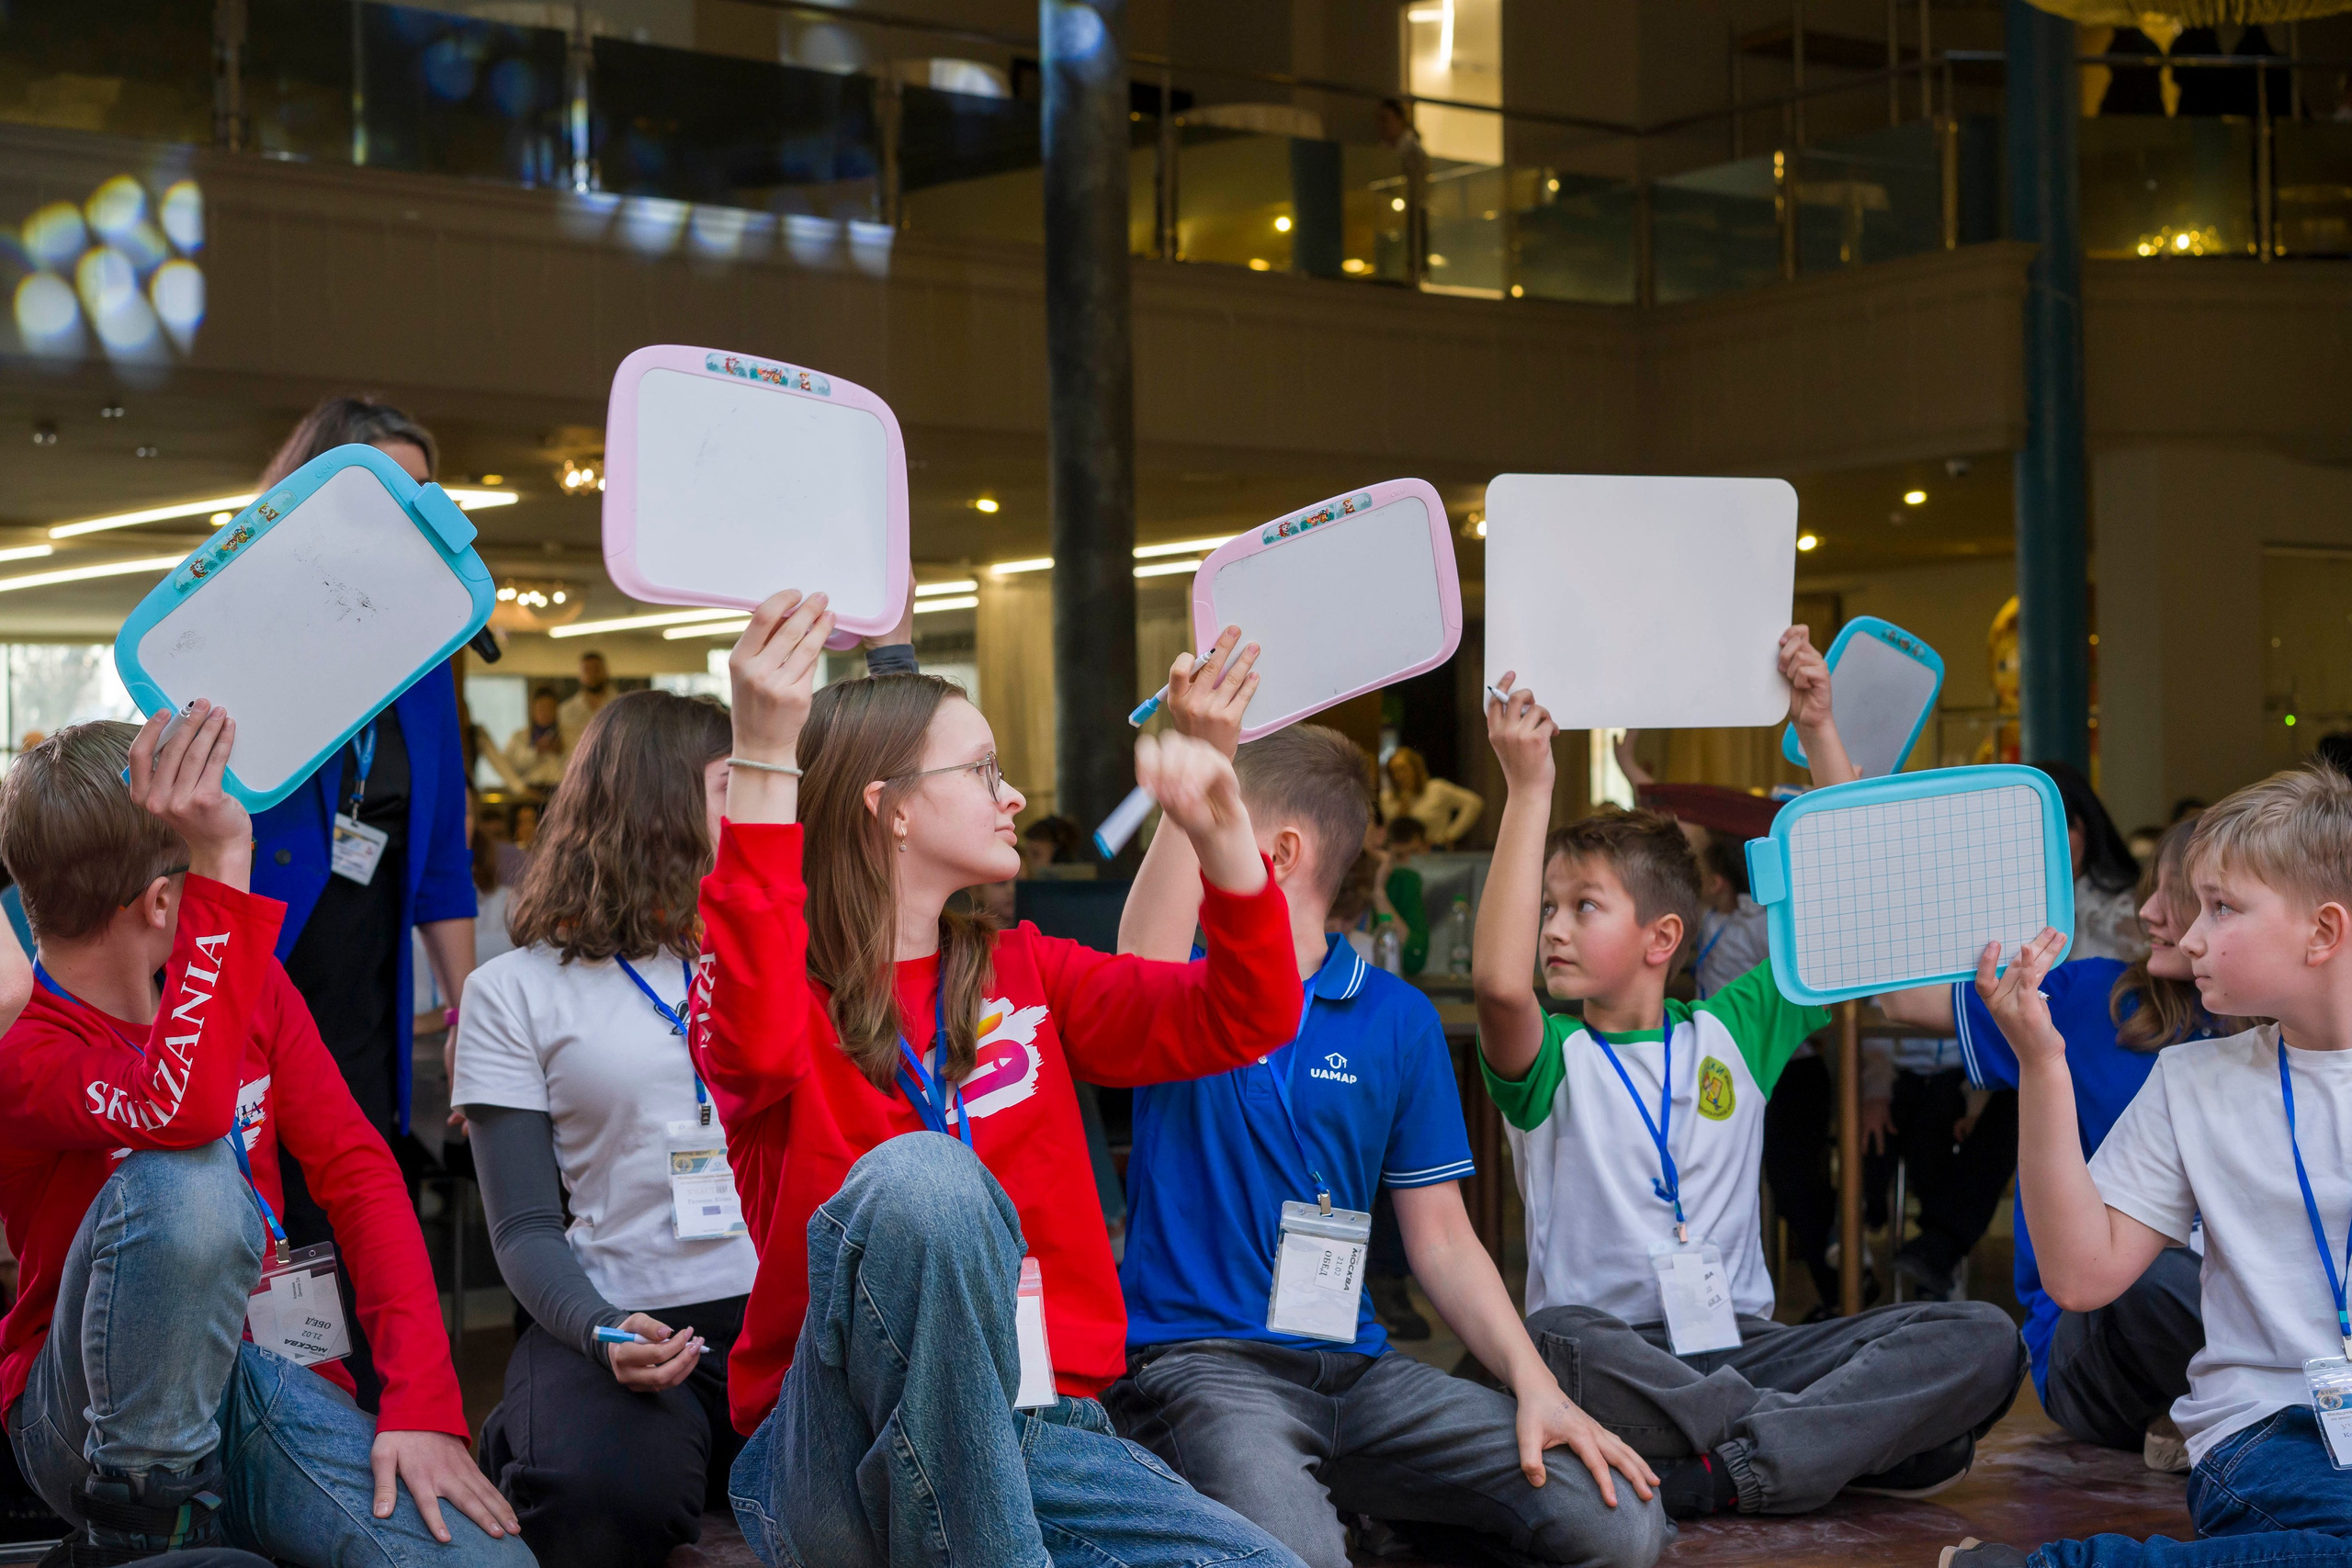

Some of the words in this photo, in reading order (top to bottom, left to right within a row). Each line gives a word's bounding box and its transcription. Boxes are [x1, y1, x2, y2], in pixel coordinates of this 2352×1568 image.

[85, 931, 231, 1132] SKILLZANIA
[1310, 1067, 1358, 1085] UAMAP
[1318, 1250, 1333, 1276] ОБЕД
[1334, 1256, 1344, 1277] 21.02
[1343, 1247, 1359, 1291] МОСКВА
[304, 1315, 332, 1330] ОБЕД
[301, 1329, 323, 1340] 21.02
[283, 1338, 329, 1353] МОСКВА
